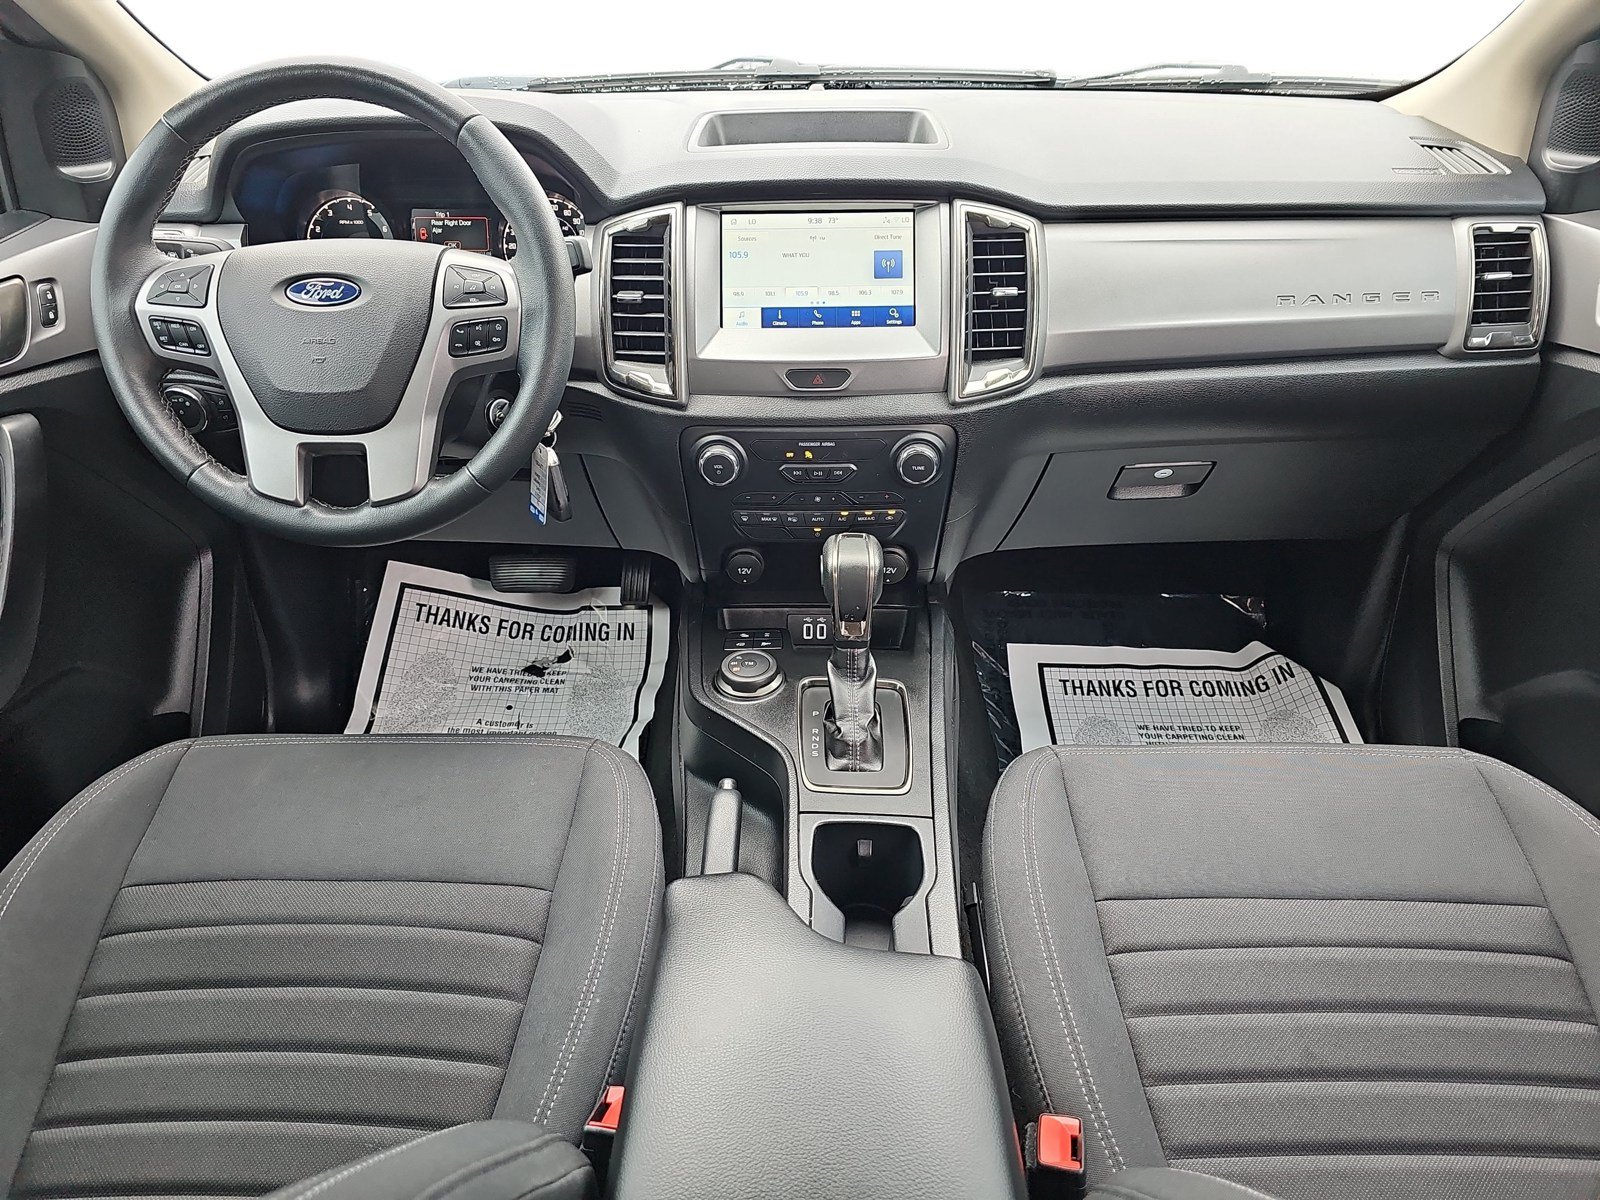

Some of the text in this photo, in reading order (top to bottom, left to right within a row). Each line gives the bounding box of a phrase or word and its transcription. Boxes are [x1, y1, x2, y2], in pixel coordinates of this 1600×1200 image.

[302, 281, 344, 299] Ford
[1276, 291, 1440, 306] RANGER
[416, 602, 491, 634] THANKS
[496, 618, 535, 641] FOR
[617, 622, 635, 641] IN
[469, 675, 491, 683] YOUR
[1059, 662, 1296, 697] THANKS FOR COMING IN
